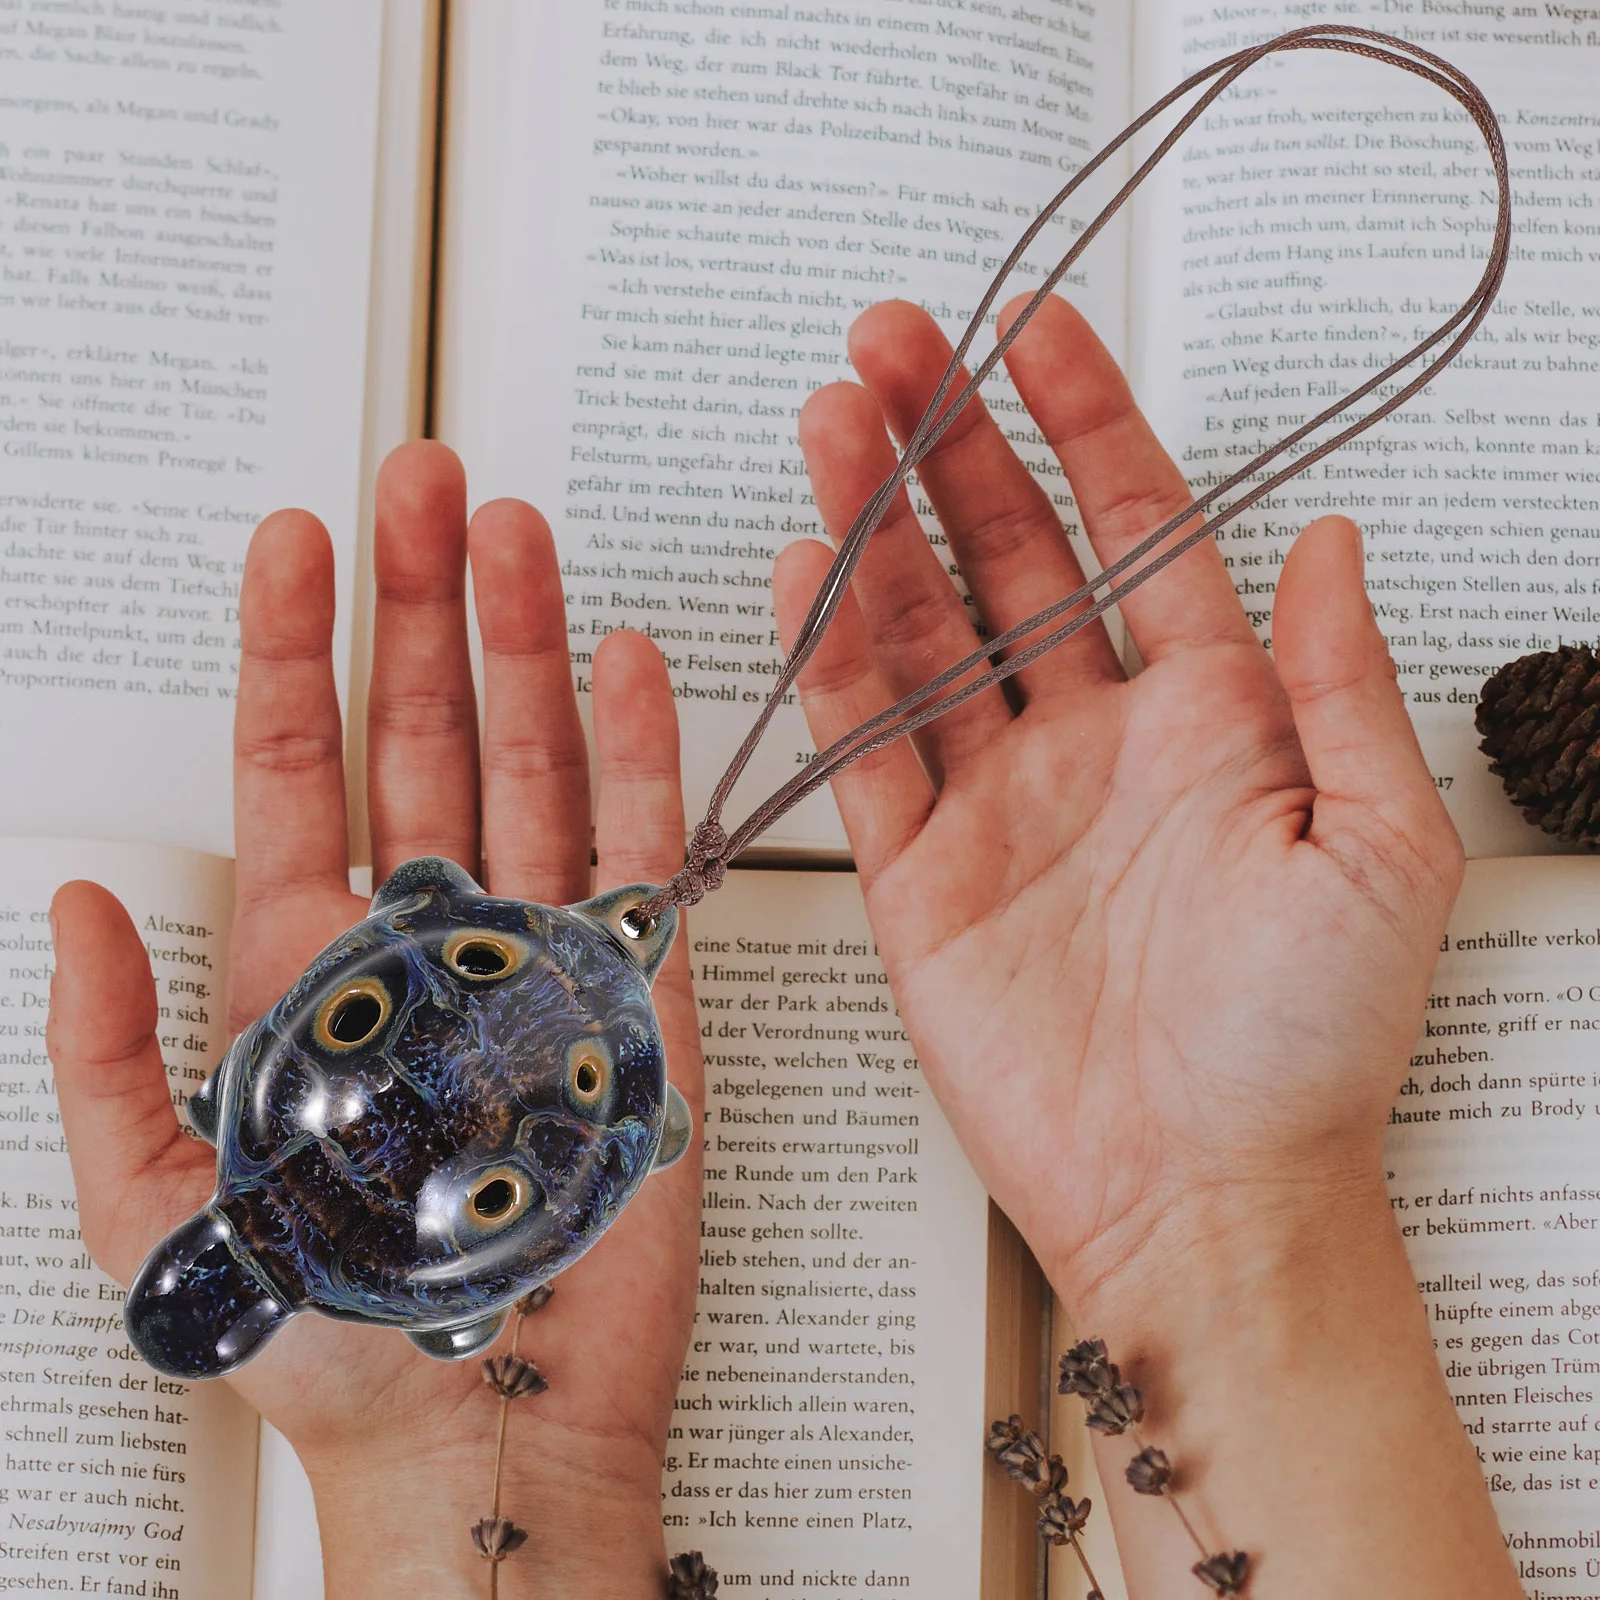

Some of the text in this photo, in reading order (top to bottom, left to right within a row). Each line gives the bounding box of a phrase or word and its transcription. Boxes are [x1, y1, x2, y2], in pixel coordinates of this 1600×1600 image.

[1404, 25, 1581, 46] hier ist sie wesentlich
[593, 140, 670, 157] gespannt
[694, 170, 740, 187] willst
[747, 172, 768, 188] du
[775, 174, 803, 191] das
[933, 192, 974, 208] mich
[982, 197, 1008, 214] sah
[1014, 206, 1030, 217] es
[1305, 188, 1474, 210] meiner Erinnerung.
[640, 252, 659, 267] ist
[665, 251, 694, 271] los,
[699, 259, 774, 274] vertraust
[780, 259, 802, 276] du
[807, 263, 837, 278] mir
[1214, 243, 1465, 266] auf dem Hang ins Laufen und
[1183, 271, 1326, 297] als ich sie auffing.
[151, 350, 217, 371] Megan.
[575, 389, 784, 416] Trick besteht darin, dass
[572, 422, 778, 445] einprägt, die sich nicht
[1324, 463, 1559, 482] Entweder ich sackte immer
[566, 504, 818, 534] sind. Und wenn du nach dort
[73, 547, 226, 575] sie auf dem Weg
[1381, 547, 1557, 566] setzte, und wich den
[581, 592, 764, 616] im Boden. Wenn wir
[1420, 604, 1548, 621] Erst nach einer
[56, 645, 220, 672] die der Leute um
[124, 679, 209, 697] an, dabei
[673, 682, 759, 702] obwohl es
[1413, 687, 1479, 704] aus den
[1431, 776, 1454, 791] 17
[145, 916, 213, 938] Alexan-
[694, 937, 866, 955] eine Statue mit drei
[1457, 930, 1537, 950] enthüllte
[1457, 988, 1496, 1007] nach
[1504, 992, 1549, 1003] vorn.
[177, 1005, 208, 1024] sich
[162, 1034, 208, 1052] er die
[713, 1078, 919, 1100] abgelegenen und weit-
[1431, 1073, 1585, 1093] doch dann spürte
[720, 1107, 918, 1126] Büschen und Bäumen
[717, 1135, 918, 1158] bereits erwartungsvoll
[759, 1194, 917, 1211] Nach der zweiten
[1402, 1226, 1420, 1236] er
[1426, 1217, 1535, 1235] bekümmert.
[761, 1280, 916, 1300] signalisierte, dass
[707, 1308, 916, 1330] waren. Alexander ging
[1436, 1302, 1553, 1324] hüpfte einem
[1446, 1328, 1560, 1352] es gegen das
[43, 1368, 190, 1395] Streifen der letz-
[706, 1365, 914, 1385] nebeneinanderstanden,
[6, 1425, 186, 1454] schnell zum liebsten
[1492, 1446, 1566, 1462] wie eine
[6, 1453, 185, 1483] hatte er sich nie fürs
[671, 1480, 911, 1499] dass er das hier zum ersten
[9, 1513, 183, 1541] Nesabyvajmy God
[81, 1576, 178, 1600] Er fand ihn
[724, 1570, 909, 1586] um und nickte dann
